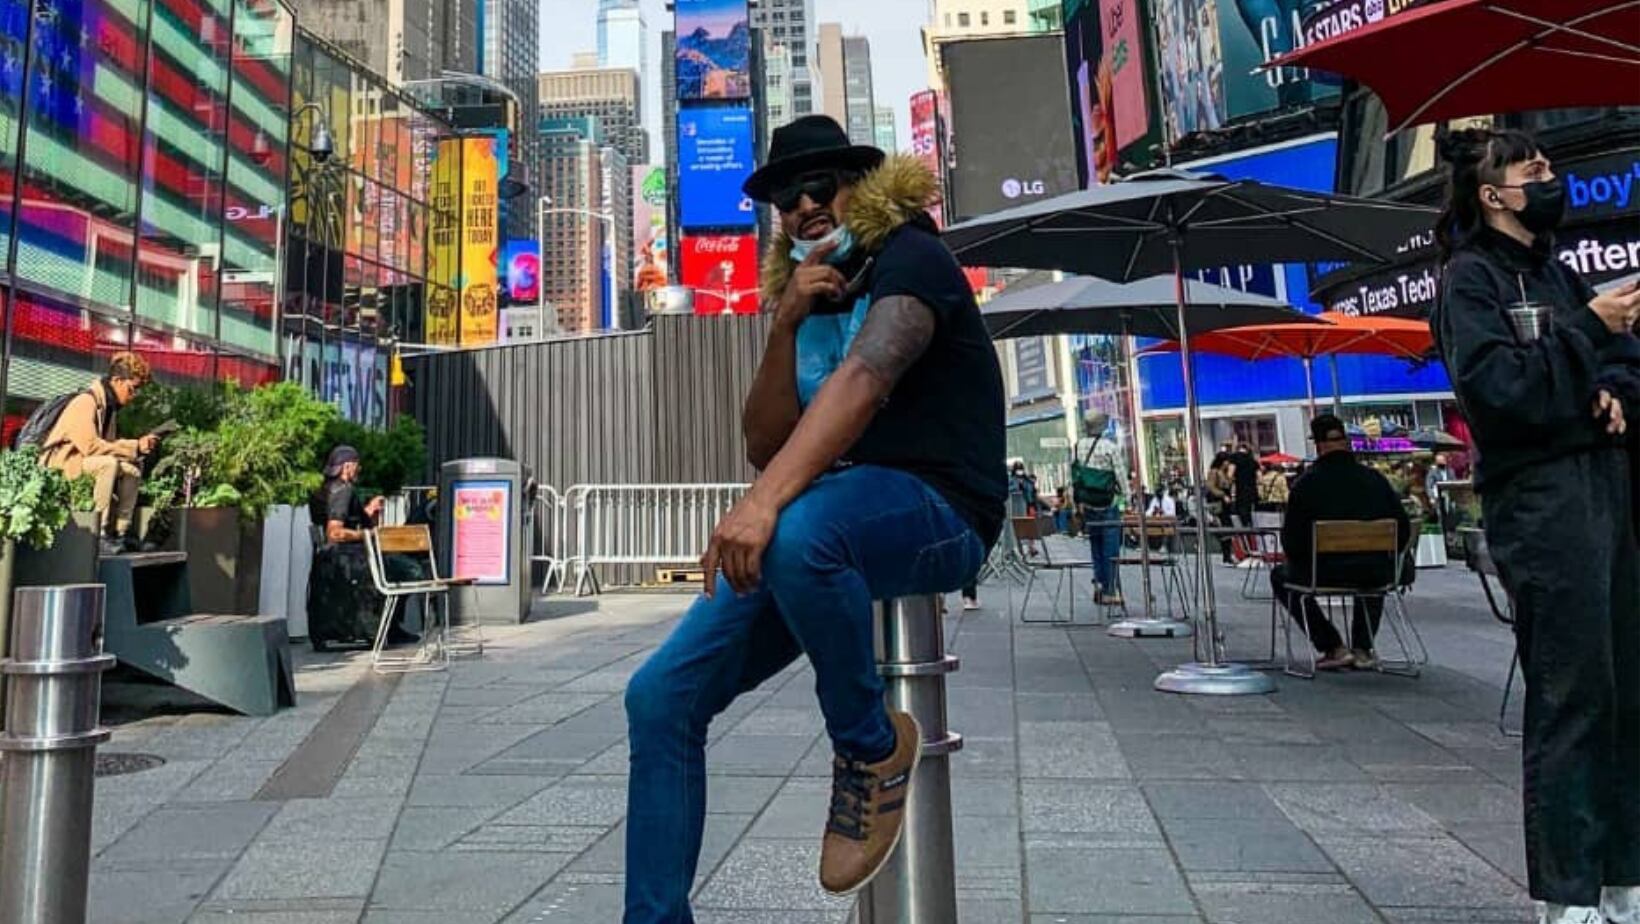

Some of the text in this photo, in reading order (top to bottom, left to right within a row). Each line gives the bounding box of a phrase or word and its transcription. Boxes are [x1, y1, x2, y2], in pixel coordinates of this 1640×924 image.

[1315, 3, 1363, 41] STARS
[1023, 181, 1045, 195] LG
[467, 208, 493, 227] HERE
[1359, 286, 1398, 314] Texas
[1398, 269, 1436, 304] Tech
